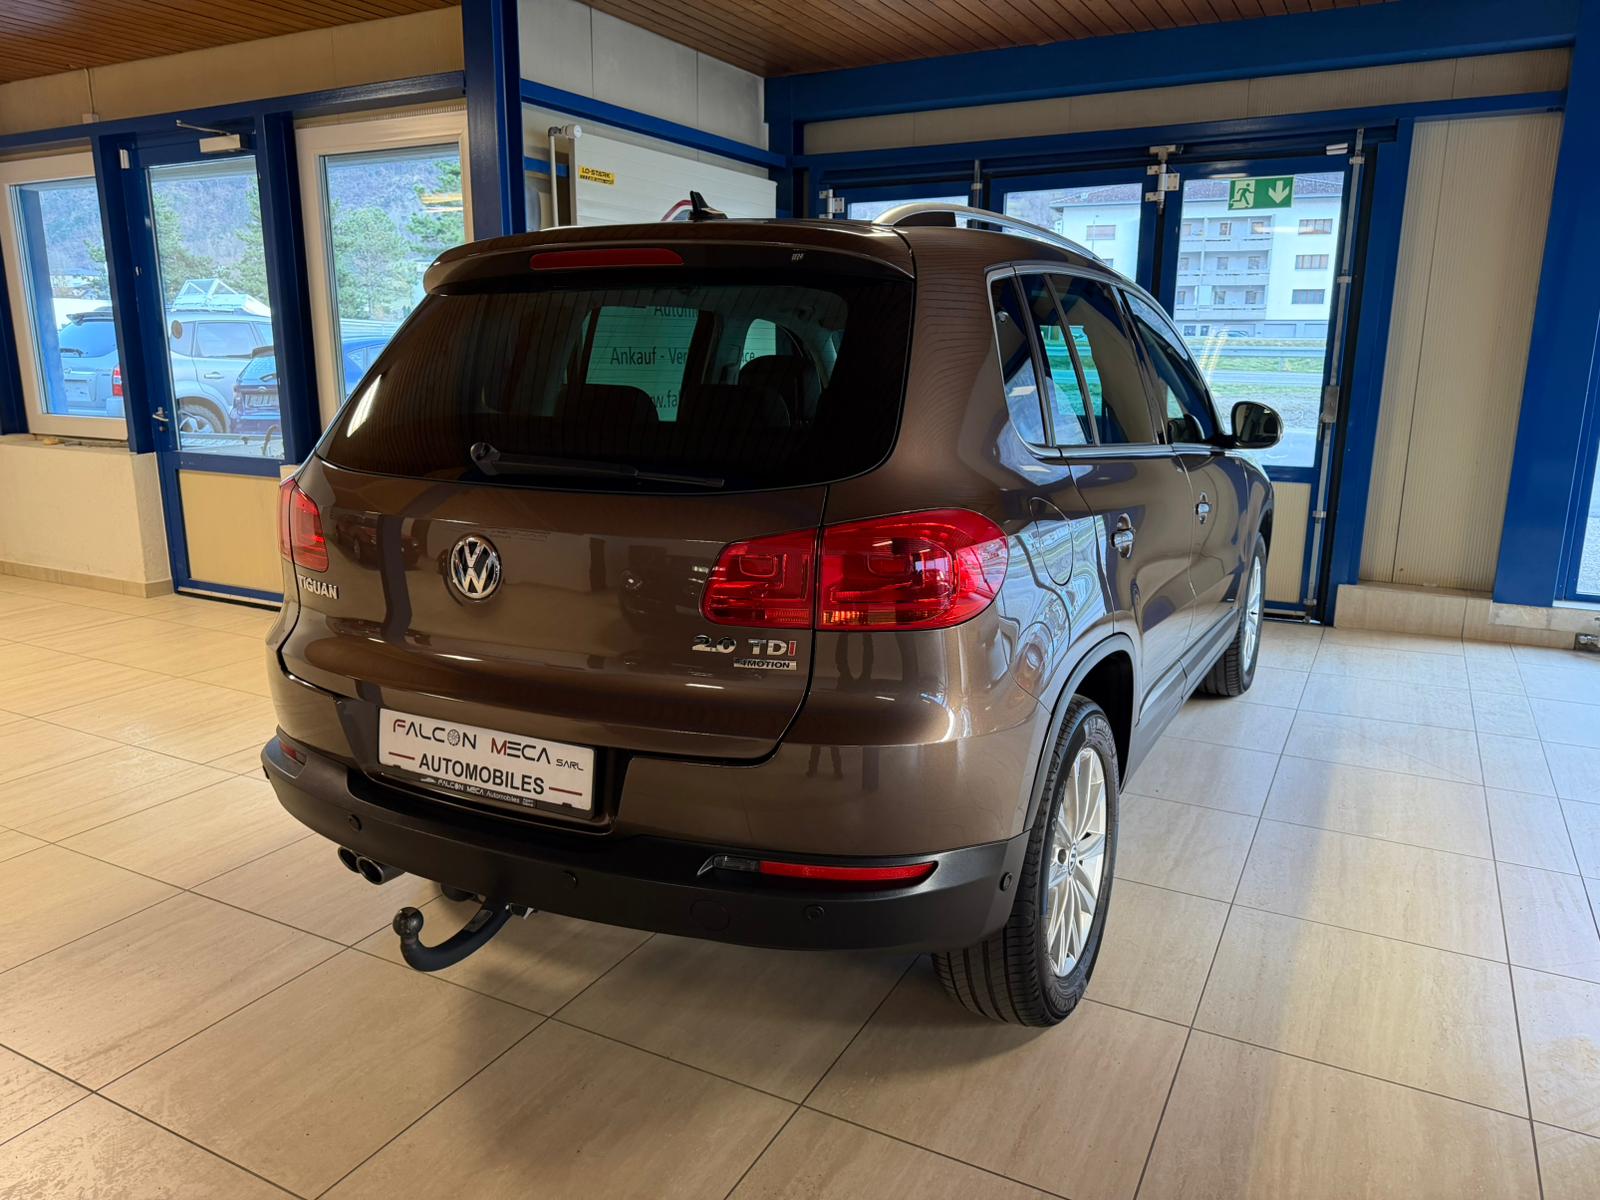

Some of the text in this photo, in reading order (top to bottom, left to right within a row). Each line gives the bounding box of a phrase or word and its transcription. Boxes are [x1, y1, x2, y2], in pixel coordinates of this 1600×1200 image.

[610, 346, 657, 365] Ankauf
[297, 574, 338, 600] TIGUAN
[692, 634, 797, 657] 2.0 TDI
[736, 659, 791, 669] 4MOTION
[393, 718, 584, 771] FALCON MECA SARL
[419, 753, 545, 795] AUTOMOBILES
[437, 779, 464, 791] FALCON
[466, 785, 485, 796] MECA
[486, 790, 520, 803] Automobiles
